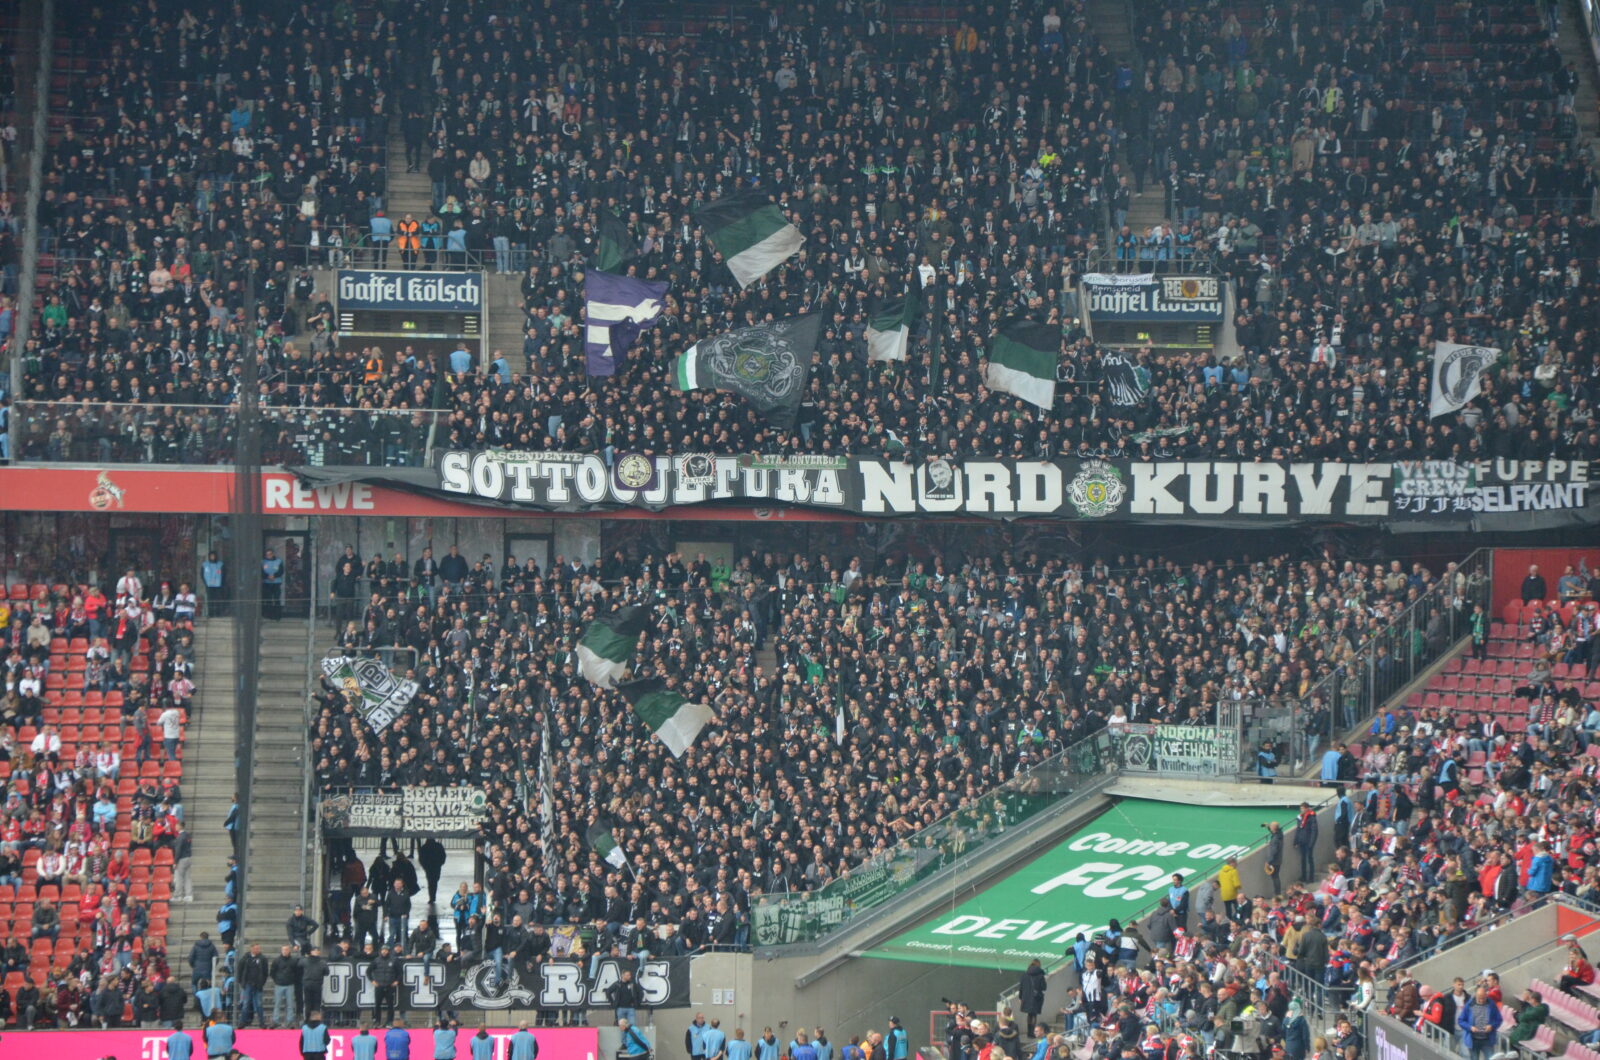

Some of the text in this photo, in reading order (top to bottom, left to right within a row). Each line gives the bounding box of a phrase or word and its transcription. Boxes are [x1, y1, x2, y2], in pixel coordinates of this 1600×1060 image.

[340, 273, 479, 306] Gaffel Kölsch
[486, 450, 583, 463] ASCENDENTE
[763, 454, 841, 466] STAIONVERBOT
[1399, 459, 1471, 479] VITUS
[265, 479, 375, 510] REWE
[859, 460, 1393, 516] NORD KURVE
[1401, 478, 1467, 496] CREW
[1472, 483, 1590, 512] SELFKANT
[403, 786, 476, 802] BEGLEIT
[351, 804, 401, 817] GEHT
[402, 801, 474, 817] SERVICE
[1068, 832, 1189, 856] Come
[1030, 862, 1197, 901] FC!
[931, 915, 1116, 944] DEVK
